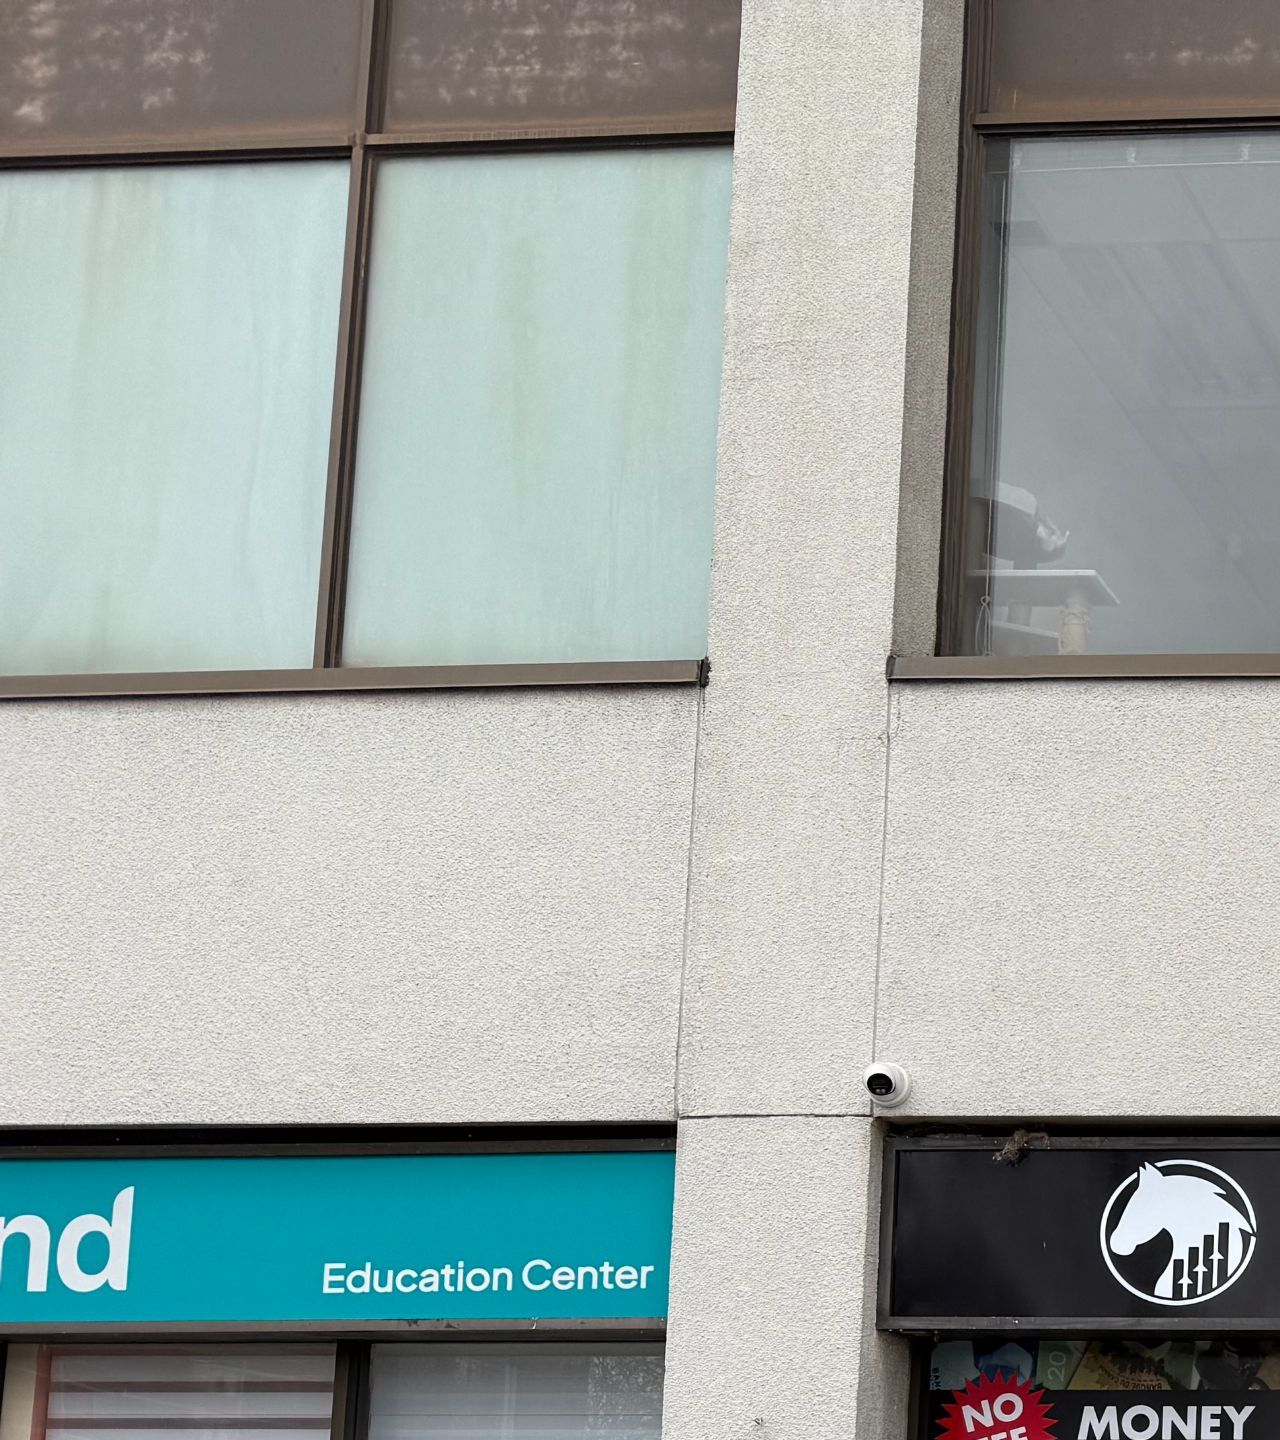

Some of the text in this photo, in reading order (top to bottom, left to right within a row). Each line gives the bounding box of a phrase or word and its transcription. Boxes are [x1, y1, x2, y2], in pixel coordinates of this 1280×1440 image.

[322, 1258, 655, 1294] Education Center
[961, 1392, 1025, 1434] NO
